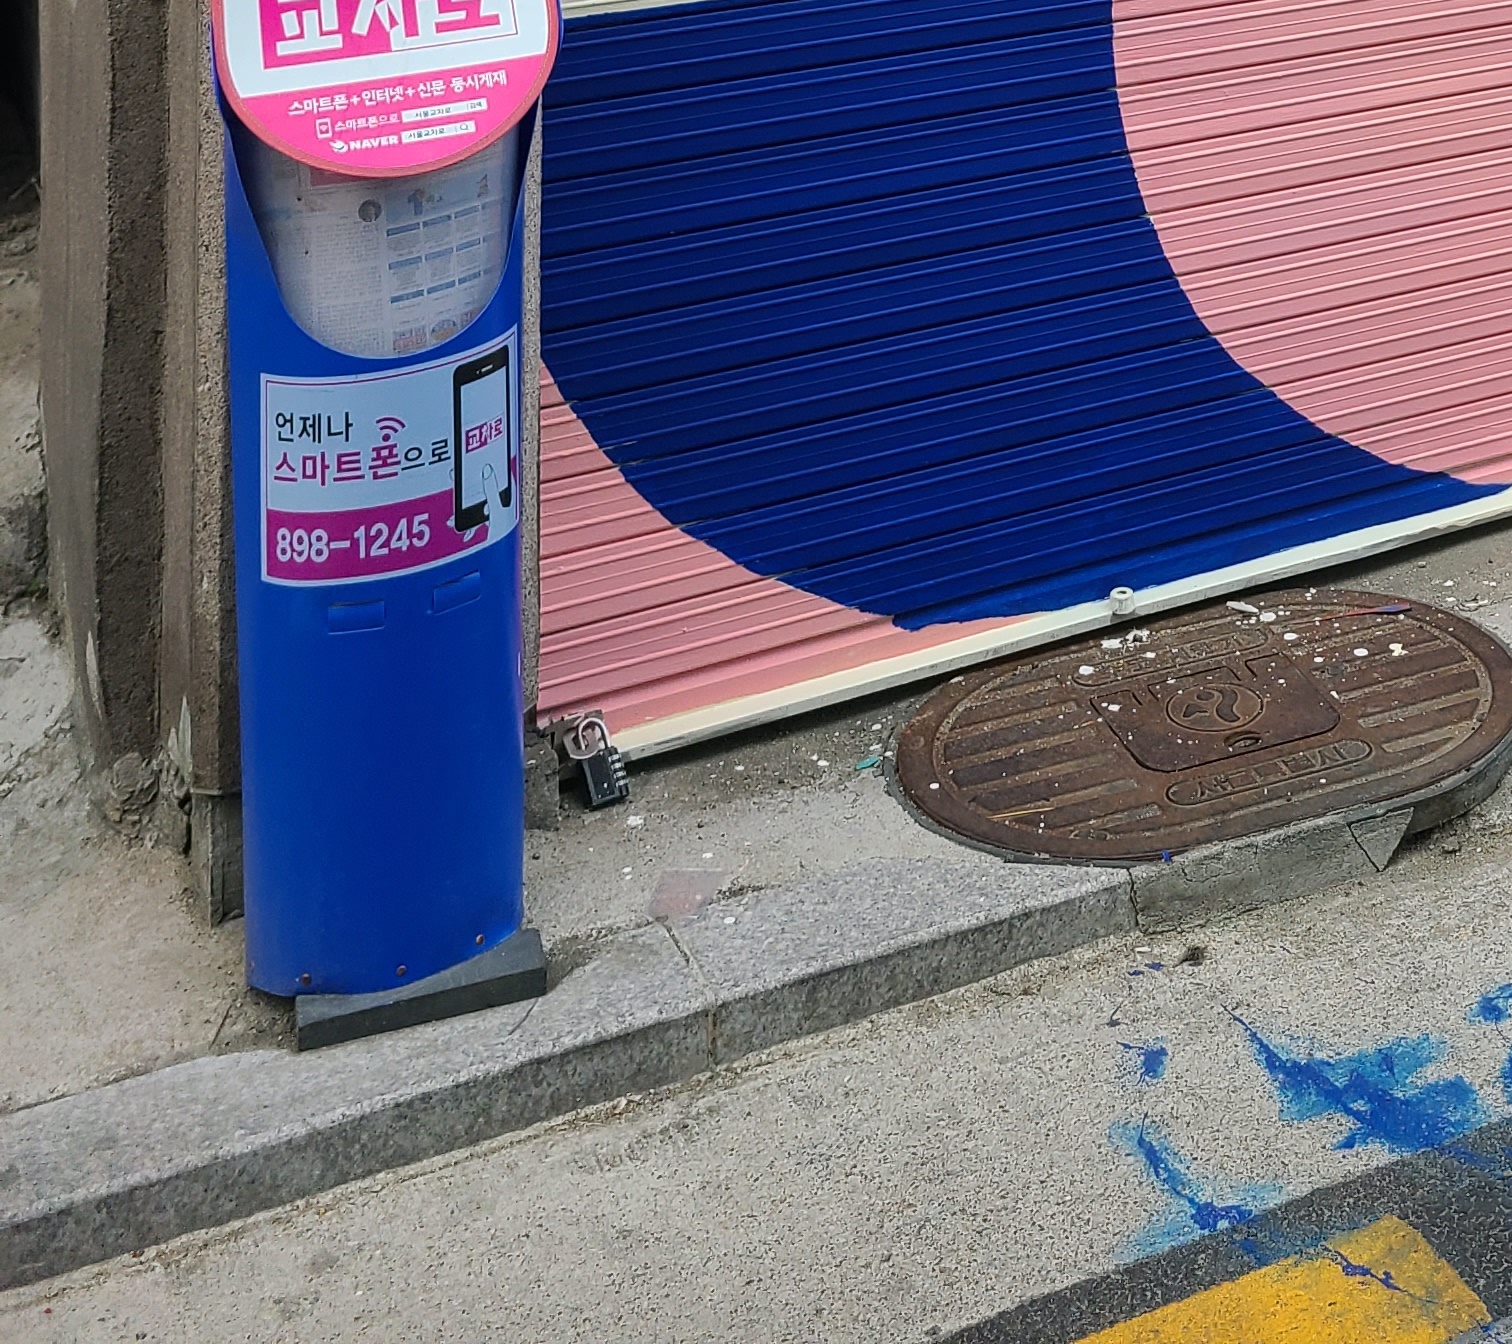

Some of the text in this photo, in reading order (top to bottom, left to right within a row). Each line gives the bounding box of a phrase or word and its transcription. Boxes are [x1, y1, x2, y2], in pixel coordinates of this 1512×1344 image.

[450, 69, 508, 93] 동시게재
[334, 113, 400, 132] 스마트폰으로
[349, 135, 399, 151] NAVER
[275, 410, 354, 444] 언제나
[273, 438, 452, 487] 스마트폰으로
[275, 513, 431, 563] 898-1245
